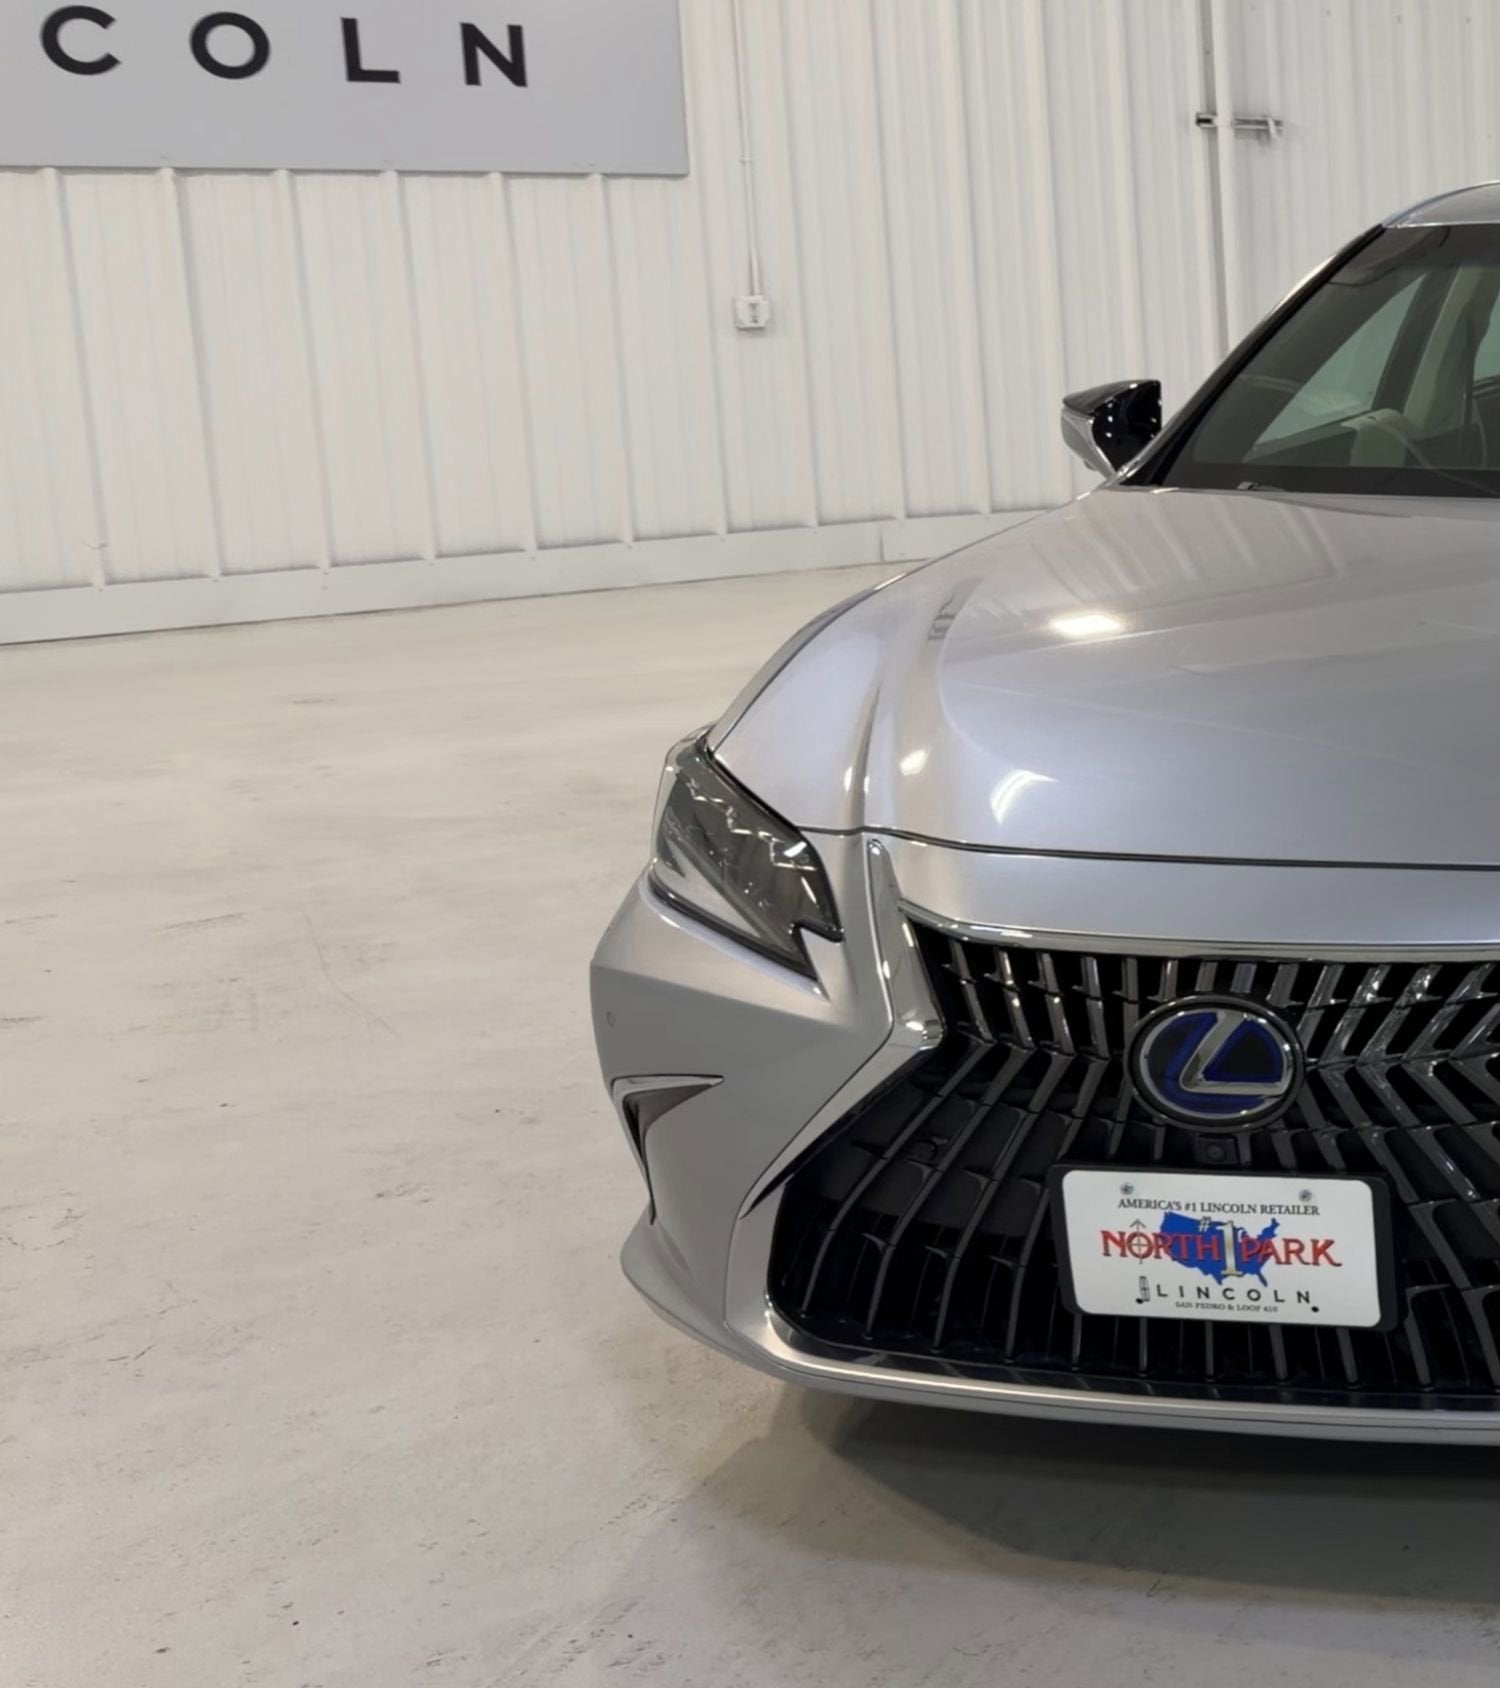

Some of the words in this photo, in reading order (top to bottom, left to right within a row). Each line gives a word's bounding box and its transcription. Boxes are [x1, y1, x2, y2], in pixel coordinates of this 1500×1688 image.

[40, 5, 529, 88] COLN
[1118, 1199, 1182, 1210] AMERICA'S
[1185, 1202, 1197, 1212] #1
[1200, 1203, 1257, 1214] LINCOLN
[1260, 1205, 1319, 1216] RETAILER
[1100, 1231, 1221, 1261] NORTH
[1240, 1237, 1342, 1267] PARK
[1156, 1284, 1311, 1304] LINCOLN
